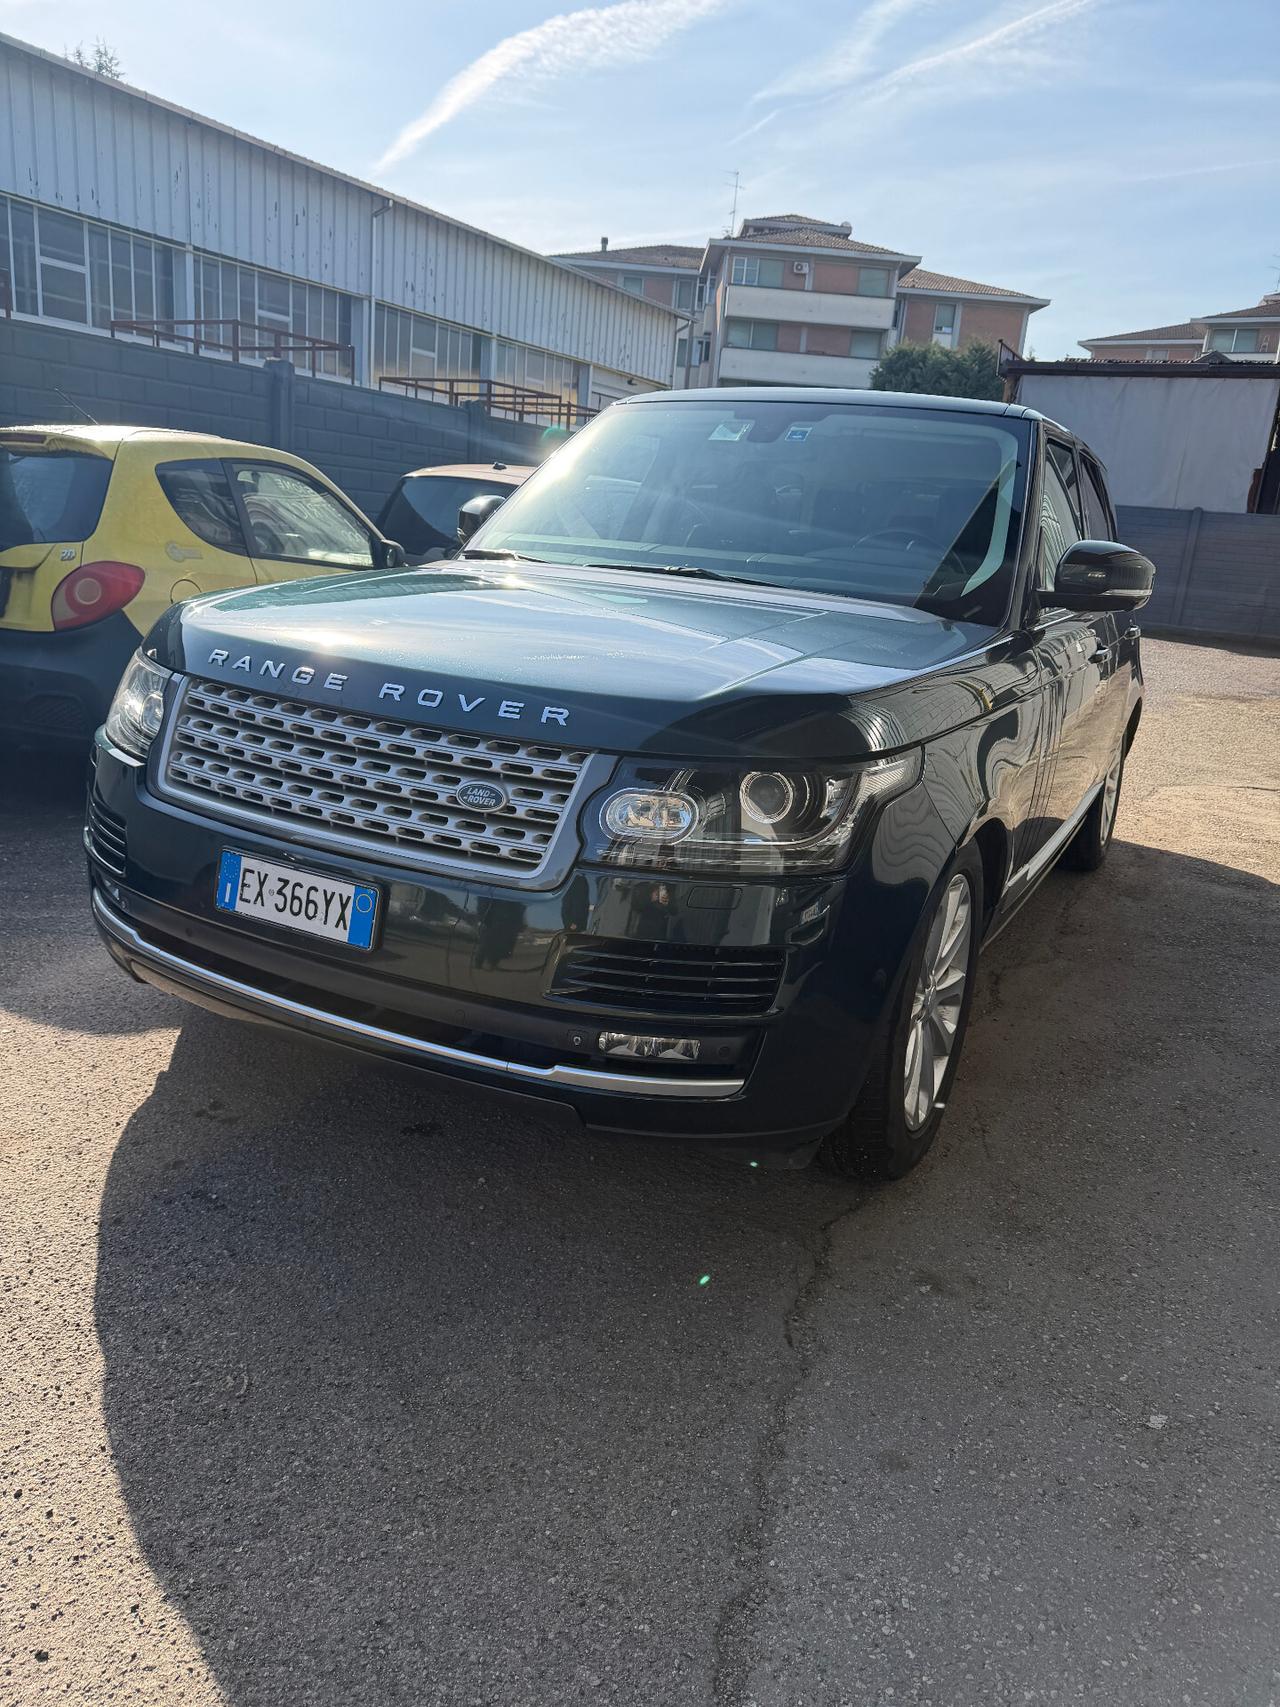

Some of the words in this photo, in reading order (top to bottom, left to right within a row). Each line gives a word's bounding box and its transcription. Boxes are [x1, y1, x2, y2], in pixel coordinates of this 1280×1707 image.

[207, 648, 348, 692] RANGE
[378, 682, 571, 726] ROVER
[467, 787, 490, 797] LAND
[467, 795, 496, 806] ROVER
